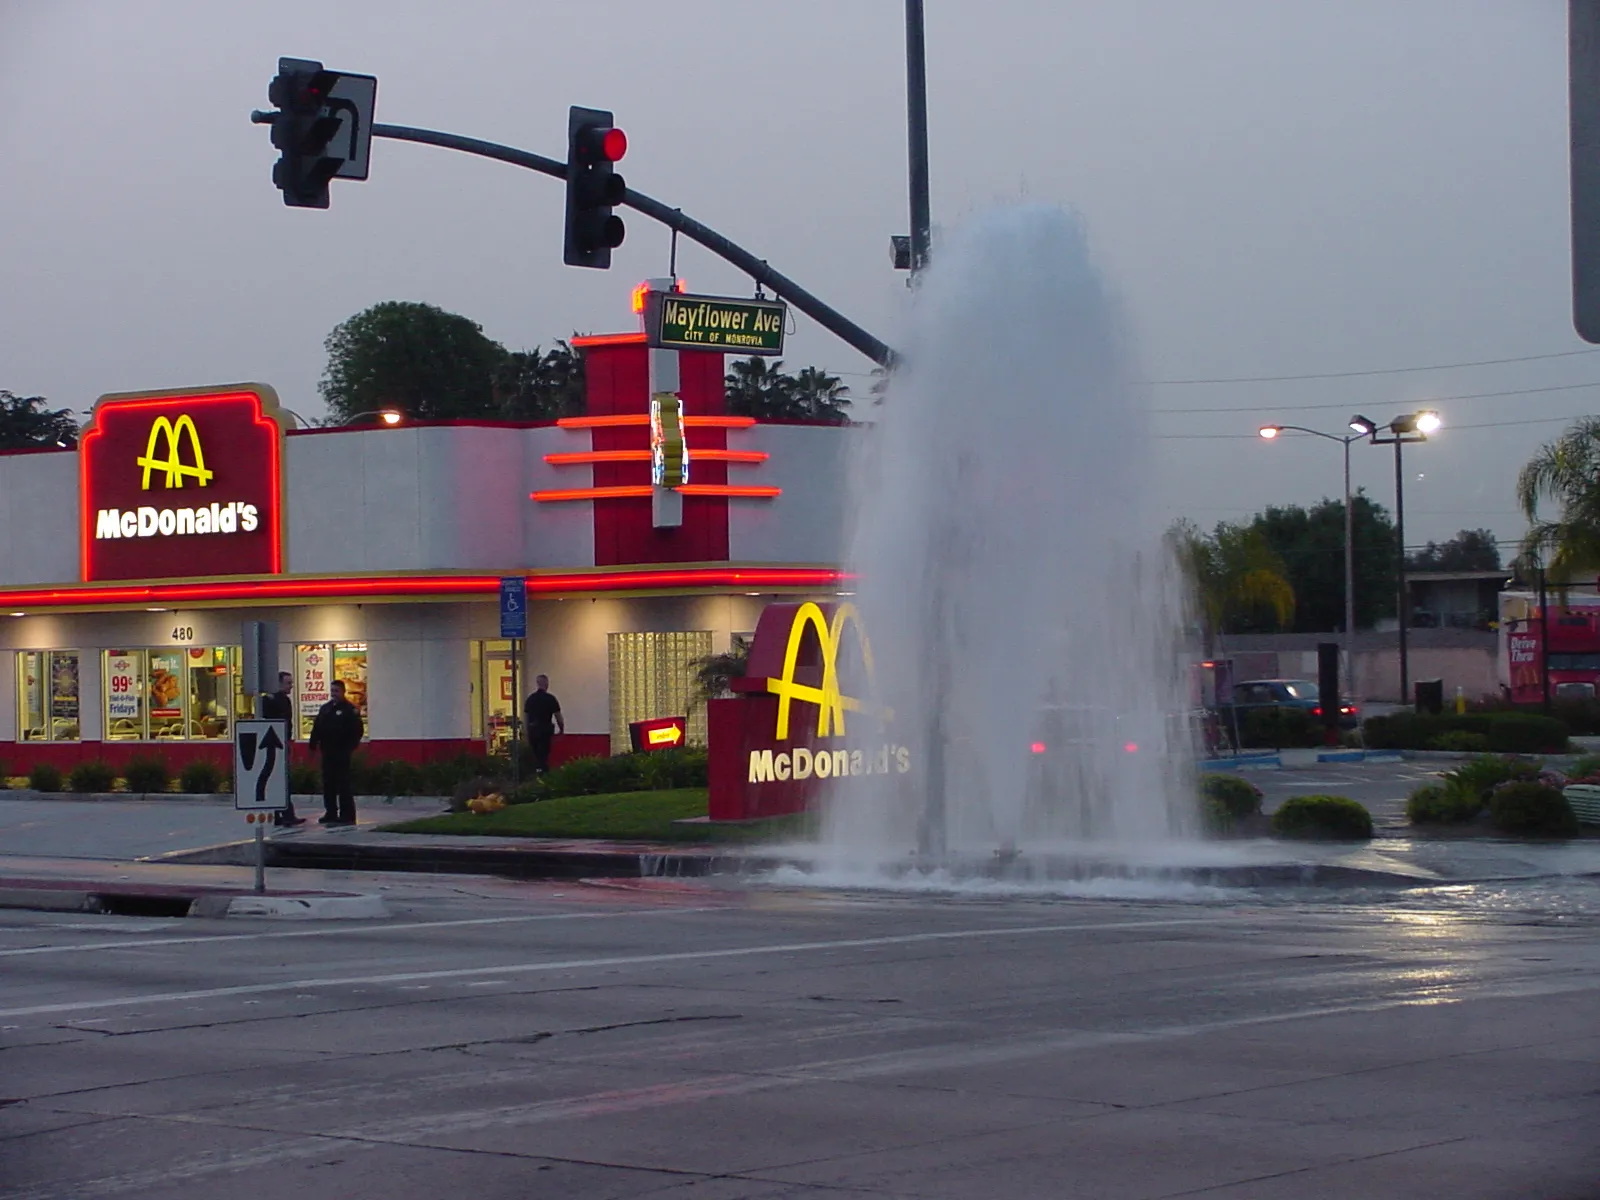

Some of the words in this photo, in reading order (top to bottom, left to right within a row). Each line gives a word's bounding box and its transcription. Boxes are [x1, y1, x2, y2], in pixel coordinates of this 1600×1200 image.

[665, 300, 749, 331] Mayflower
[753, 308, 781, 333] Ave
[684, 330, 704, 342] CITY
[709, 332, 720, 343] OF
[725, 333, 763, 346] MONROVIA
[95, 501, 259, 540] McDonald's
[171, 626, 194, 641] 480
[306, 669, 311, 680] 2
[313, 669, 323, 680] for
[109, 703, 136, 716] Fridays
